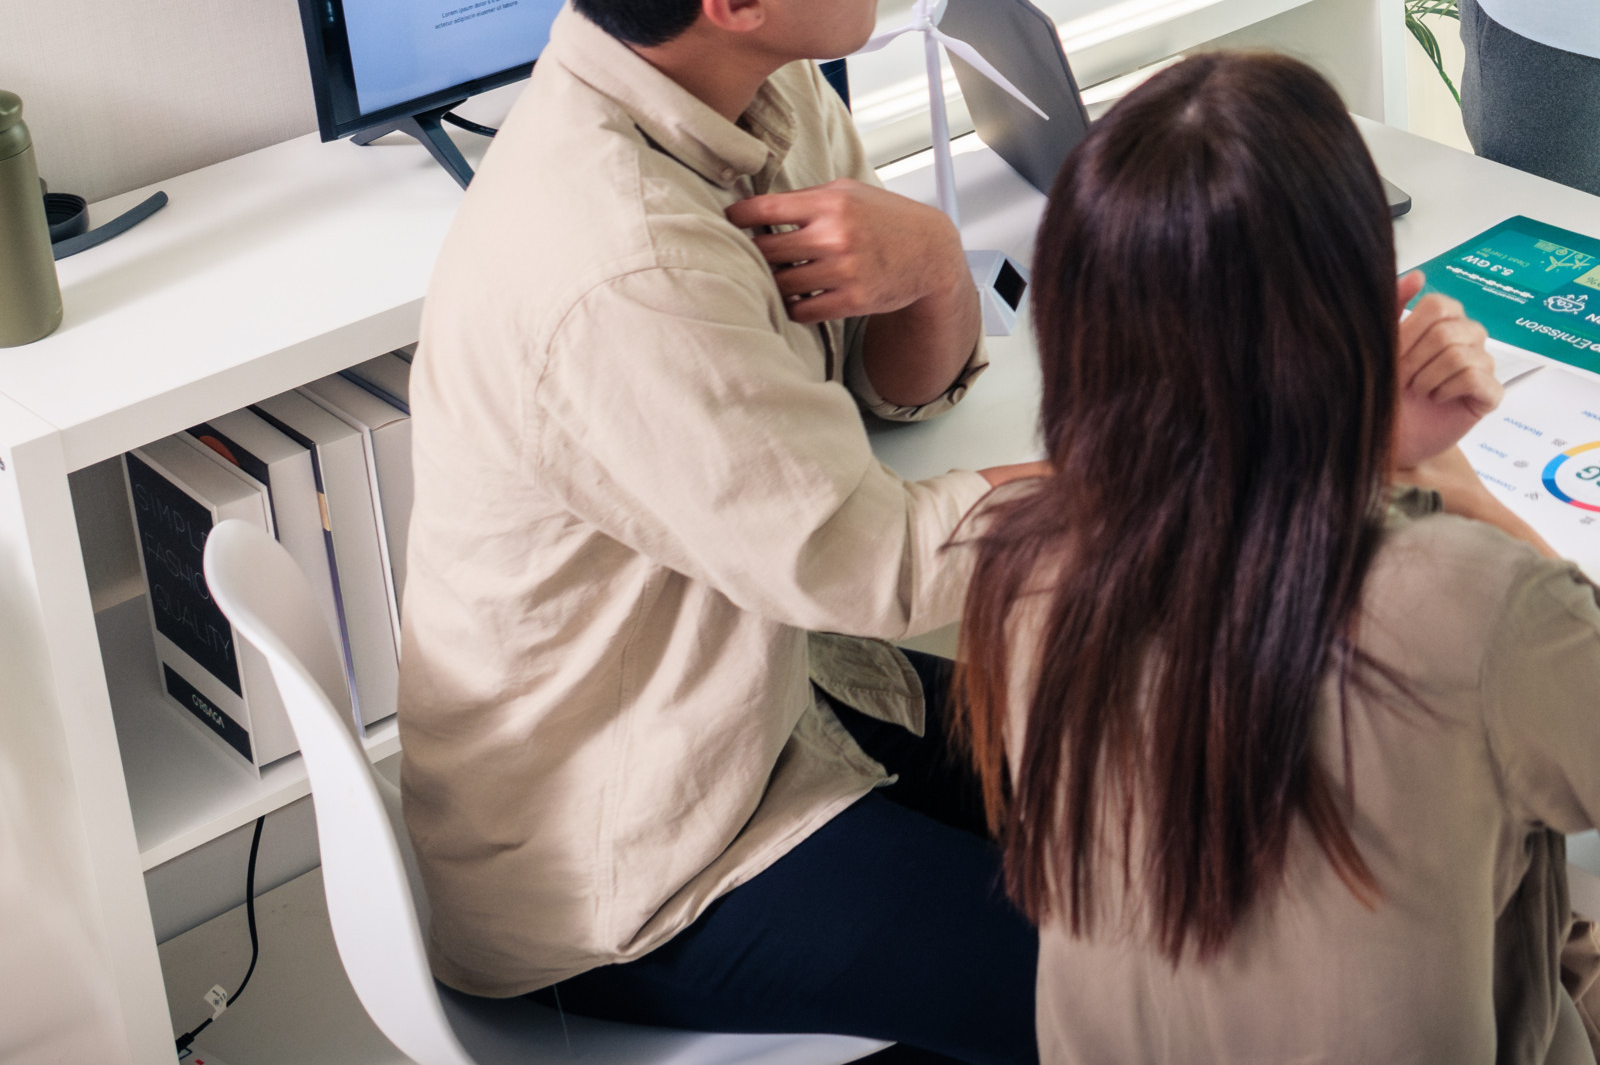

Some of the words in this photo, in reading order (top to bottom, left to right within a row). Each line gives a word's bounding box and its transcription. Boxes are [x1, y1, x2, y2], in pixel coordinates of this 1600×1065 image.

[1461, 254, 1491, 268] GW
[1477, 246, 1506, 262] Energy
[1509, 255, 1530, 268] Clean
[1492, 264, 1514, 276] 5.3
[1515, 317, 1593, 349] Emission
[144, 532, 212, 602] FASHIO
[155, 584, 230, 660] QUALITY
